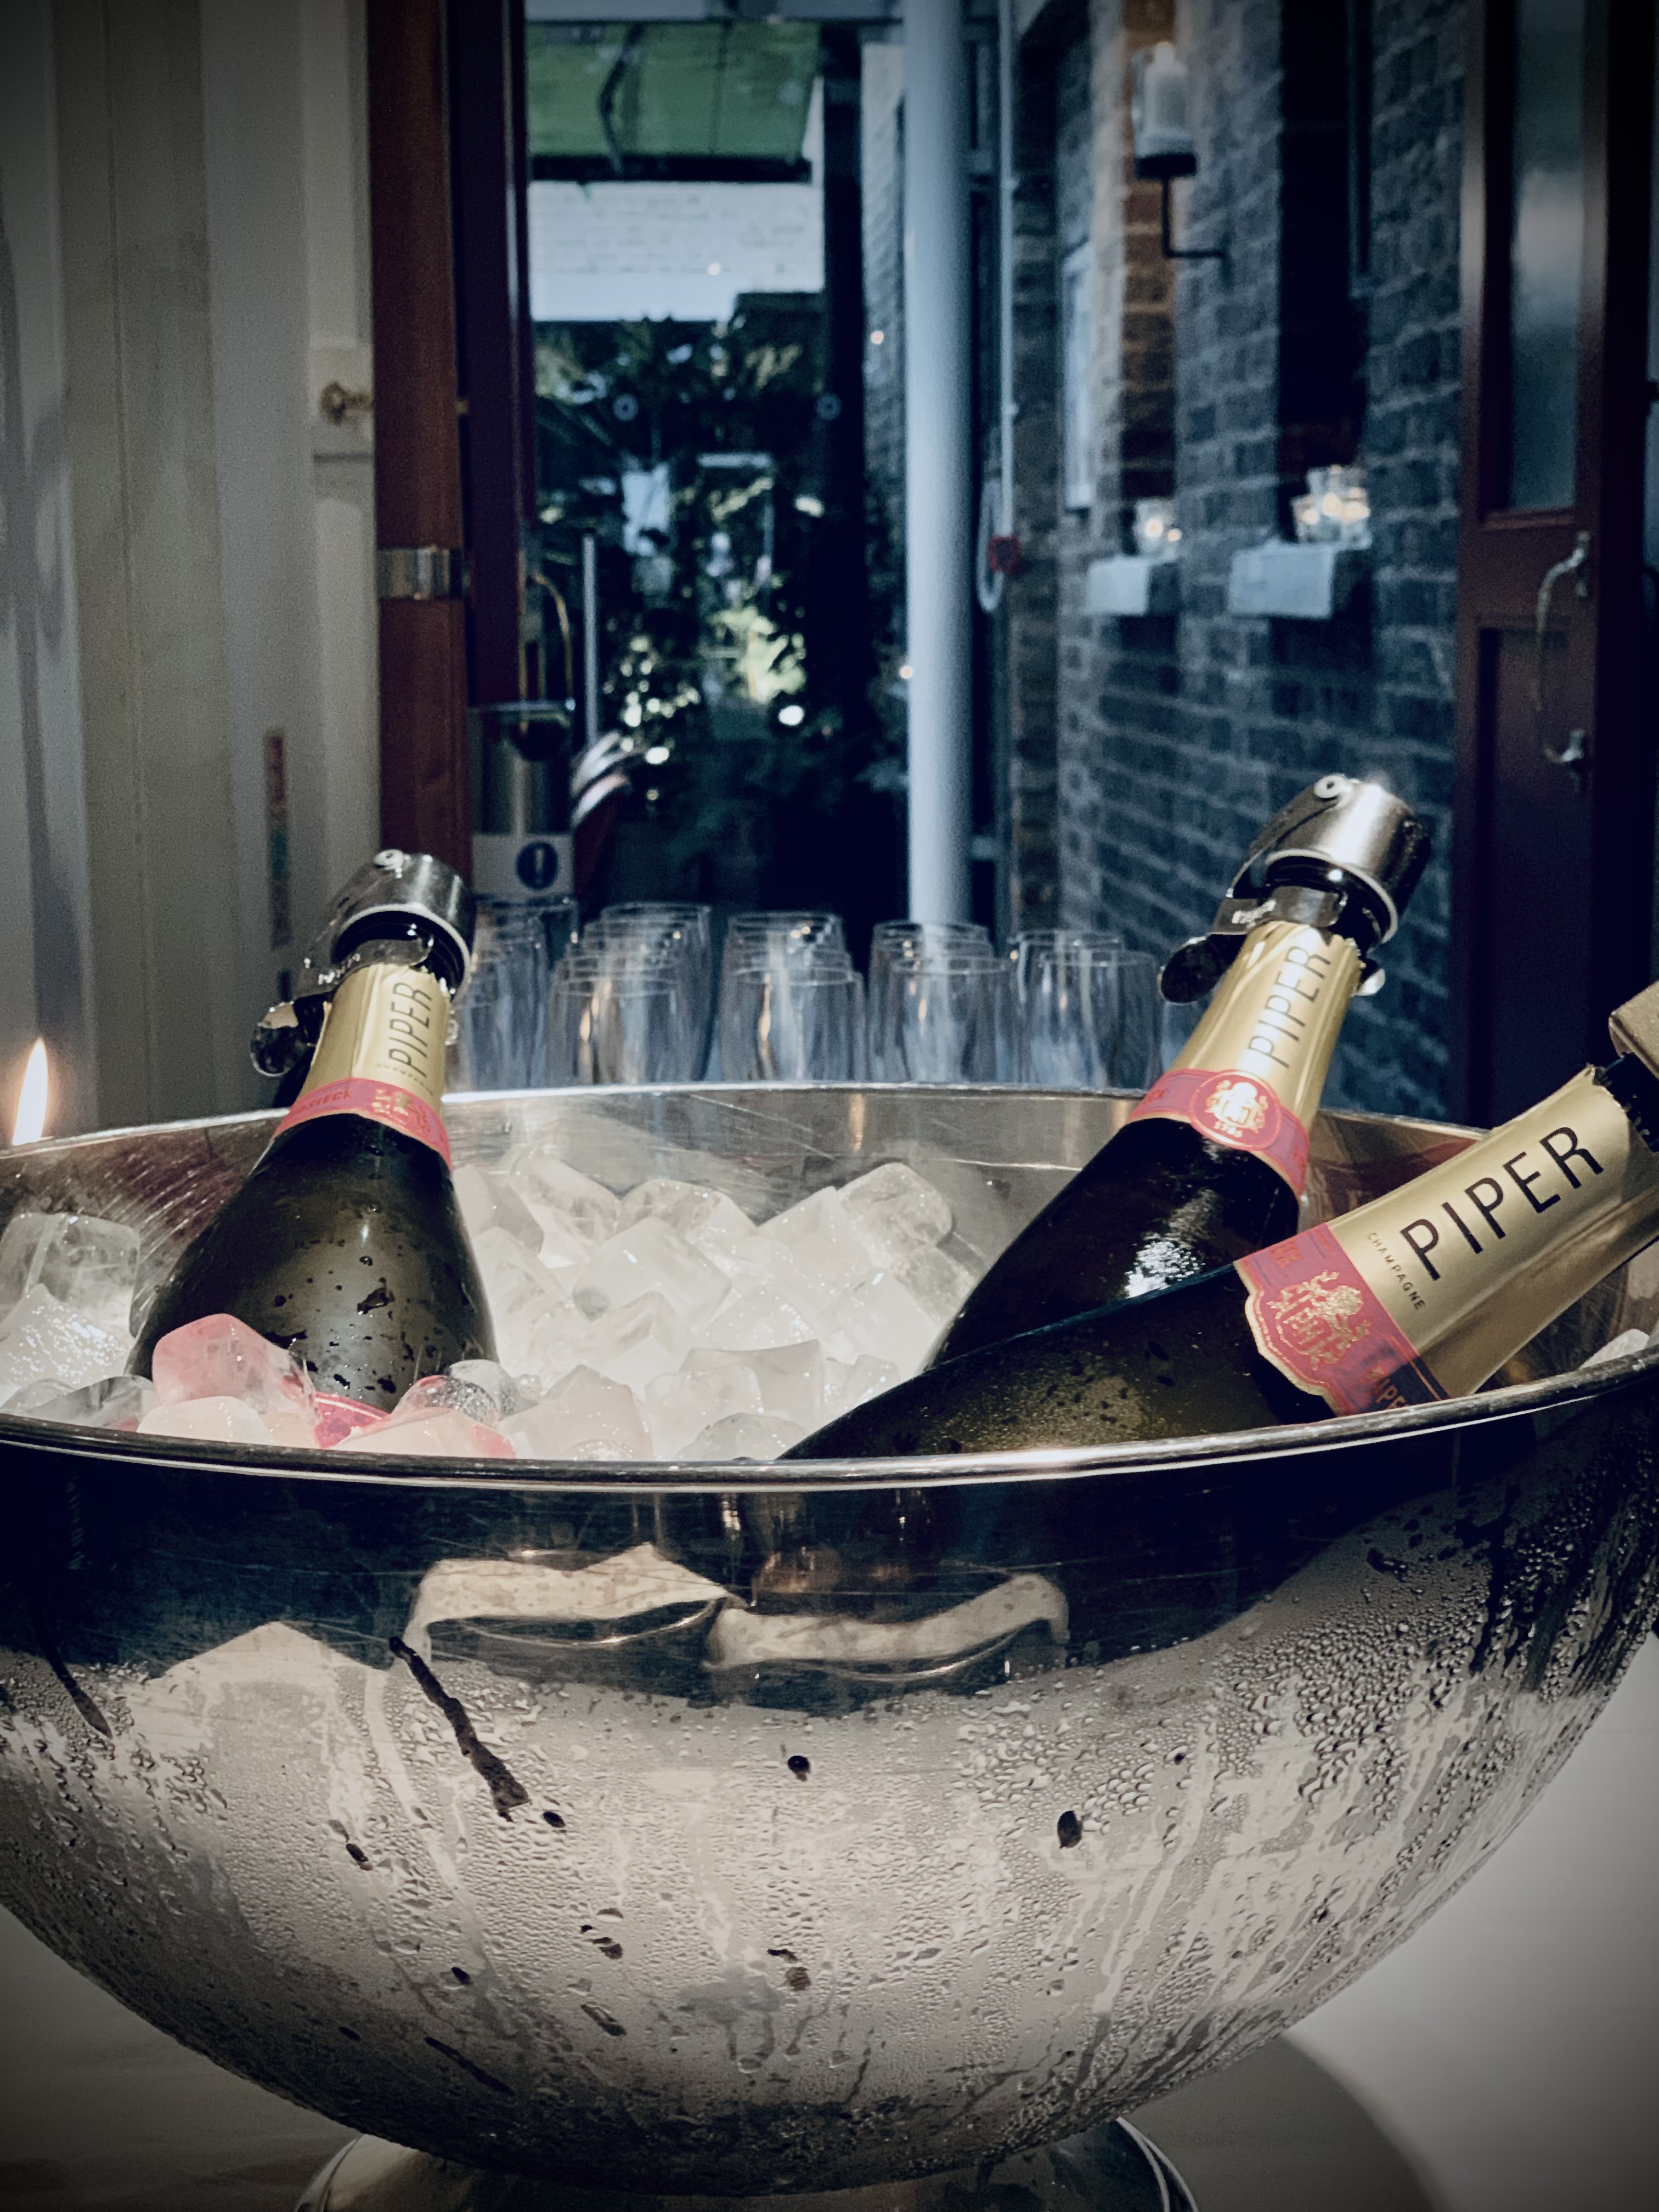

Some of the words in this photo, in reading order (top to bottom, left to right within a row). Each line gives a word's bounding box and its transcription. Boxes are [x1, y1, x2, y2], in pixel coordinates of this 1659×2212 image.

[388, 982, 432, 1079] PIPER
[1248, 946, 1331, 1069] PIPER
[1400, 1126, 1604, 1281] PIPER
[1367, 1232, 1426, 1310] CHAMPAGNE
